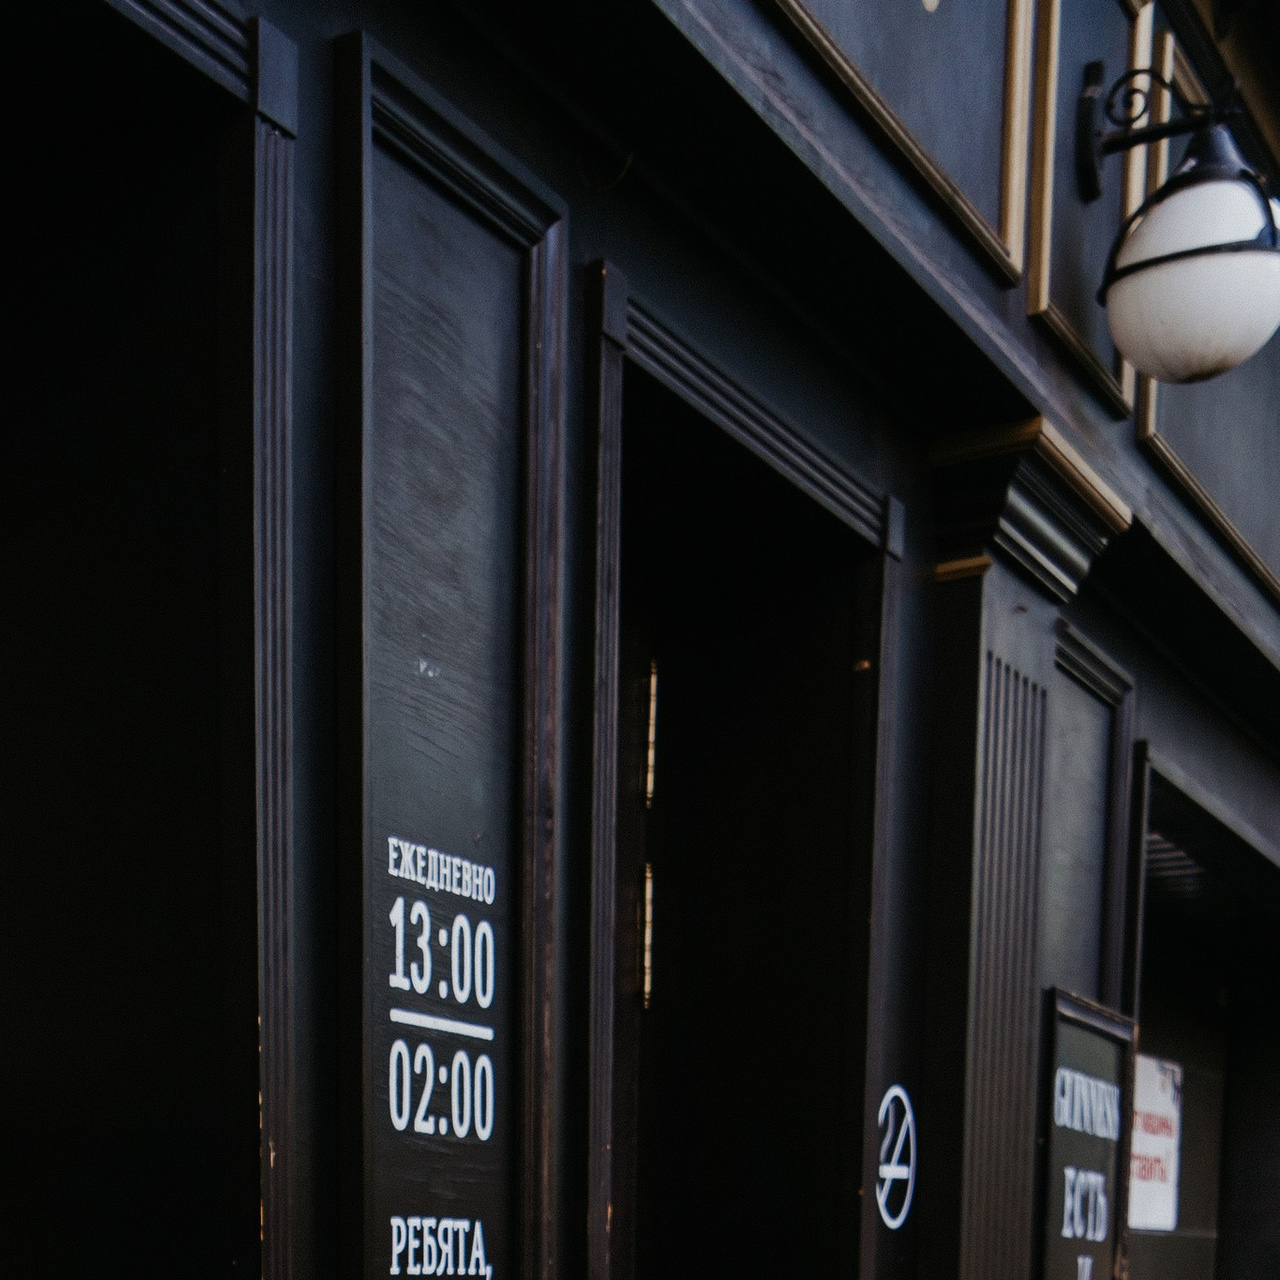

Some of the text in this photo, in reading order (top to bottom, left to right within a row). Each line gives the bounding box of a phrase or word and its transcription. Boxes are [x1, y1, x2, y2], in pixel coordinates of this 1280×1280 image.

[387, 836, 496, 905] ЕЖЕДНЕВНО
[389, 896, 495, 1009] 13:00
[389, 1039, 495, 1142] 02:00
[1061, 1166, 1108, 1242] ЕСТЬ
